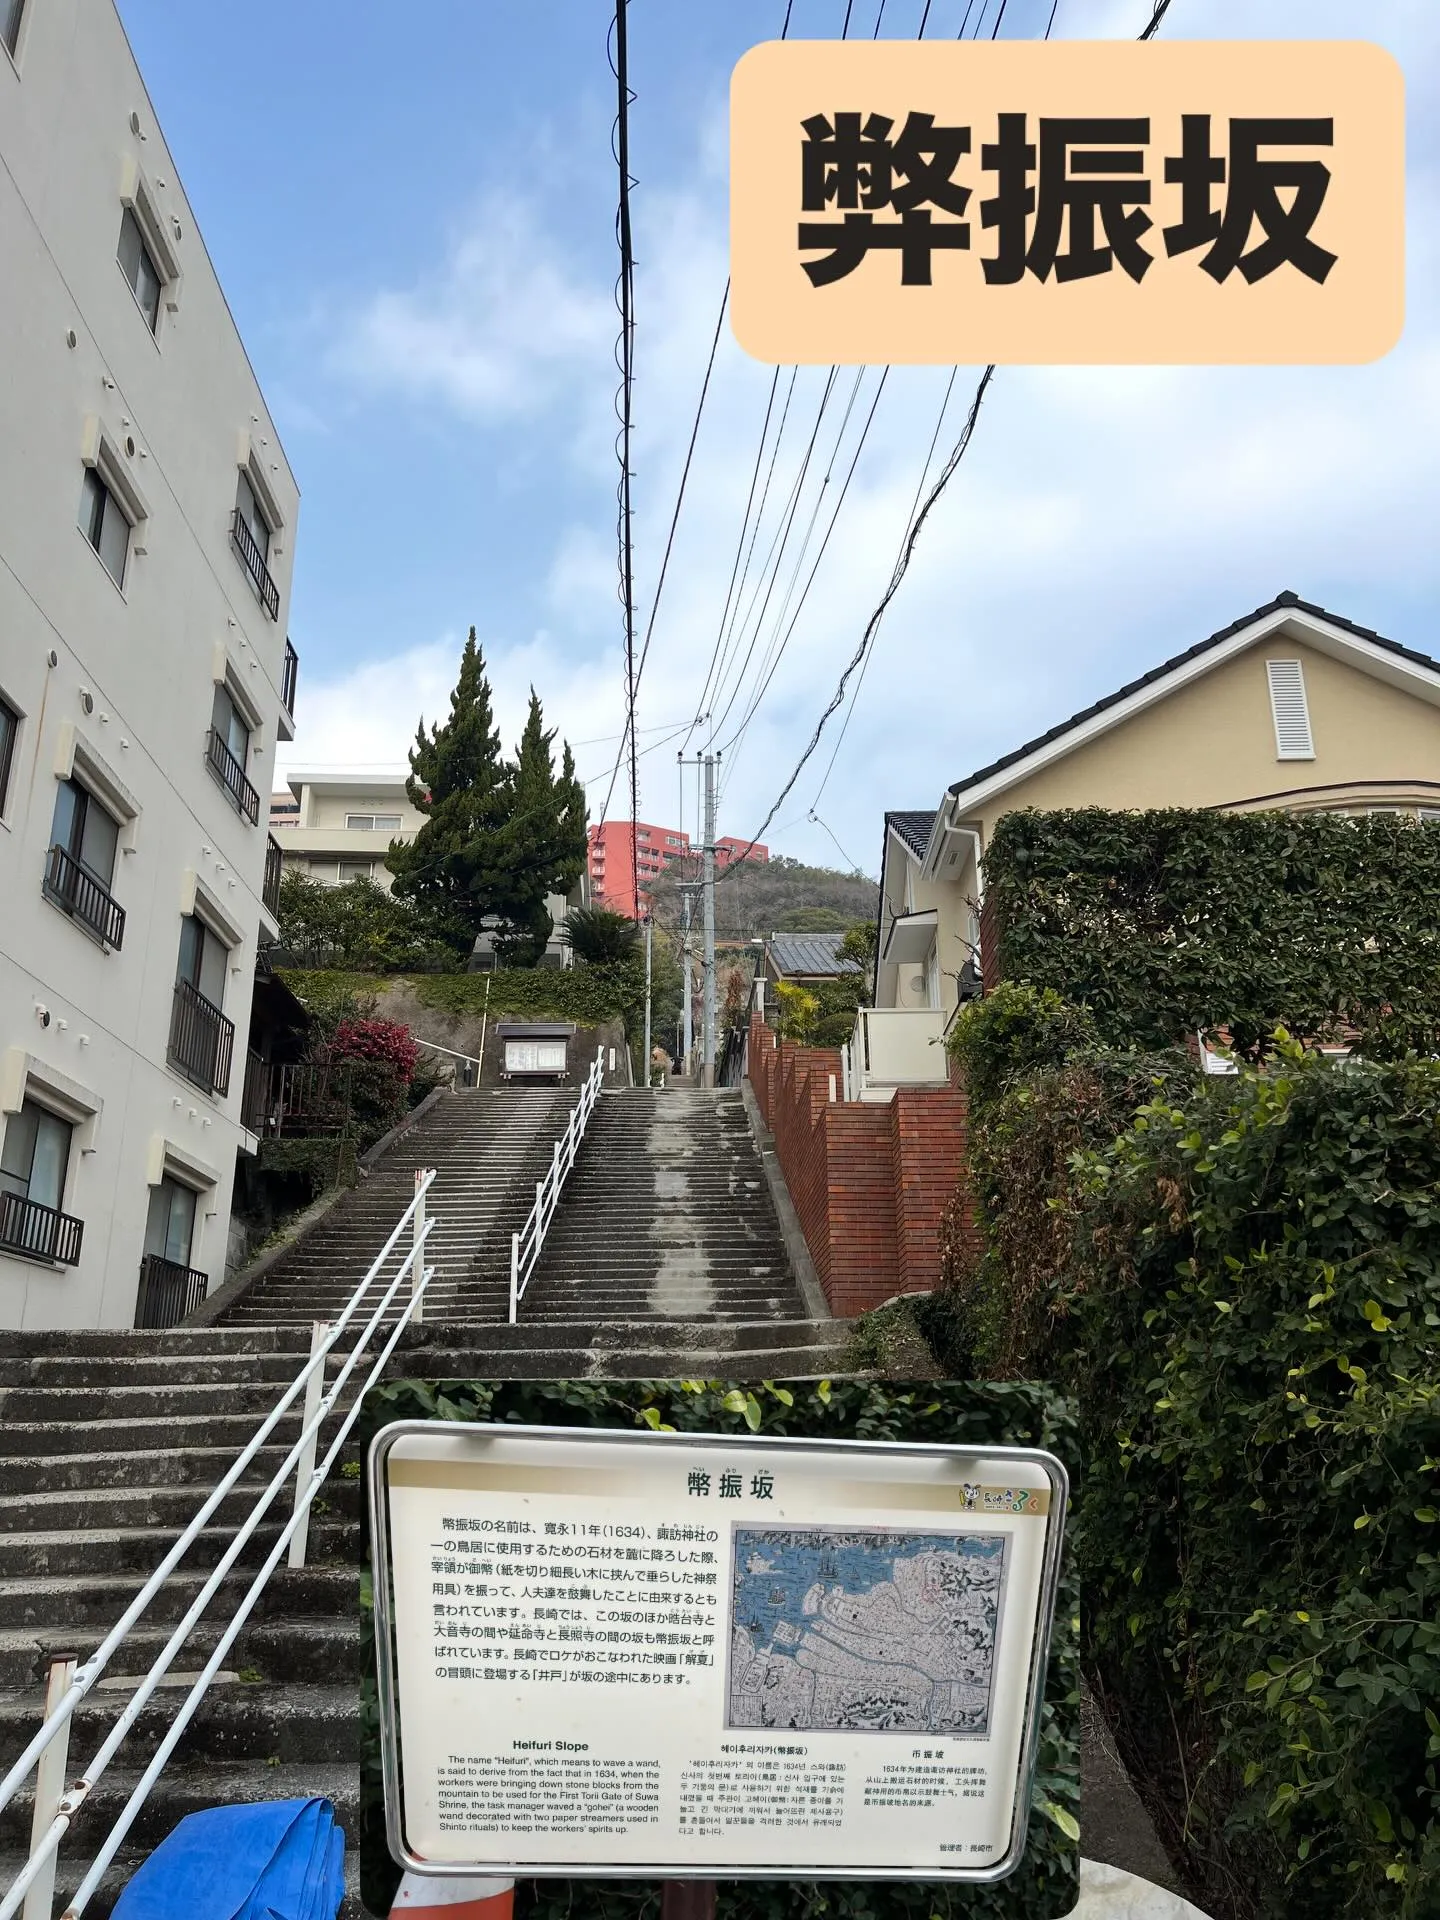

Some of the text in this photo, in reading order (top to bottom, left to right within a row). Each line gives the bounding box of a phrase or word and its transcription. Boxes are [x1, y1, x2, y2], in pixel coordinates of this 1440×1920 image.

[687, 1472, 775, 1500] 幣振坂
[435, 1667, 691, 1685] の冒頭に登場する「井戸」が坂の途中にあります。
[513, 1740, 589, 1752] Heifuri Slope
[448, 1756, 465, 1764] The
[636, 1760, 660, 1768] wand,
[595, 1770, 618, 1778] 1634,
[501, 1780, 536, 1789] bringing
[593, 1781, 620, 1789] blocks
[439, 1801, 468, 1809] Shrine,
[439, 1812, 463, 1820] wand
[440, 1823, 467, 1831] Shinto
[469, 1824, 498, 1832] rituals)
[512, 1824, 532, 1833] keep
[535, 1824, 548, 1832] the
[589, 1826, 613, 1834] spirits
